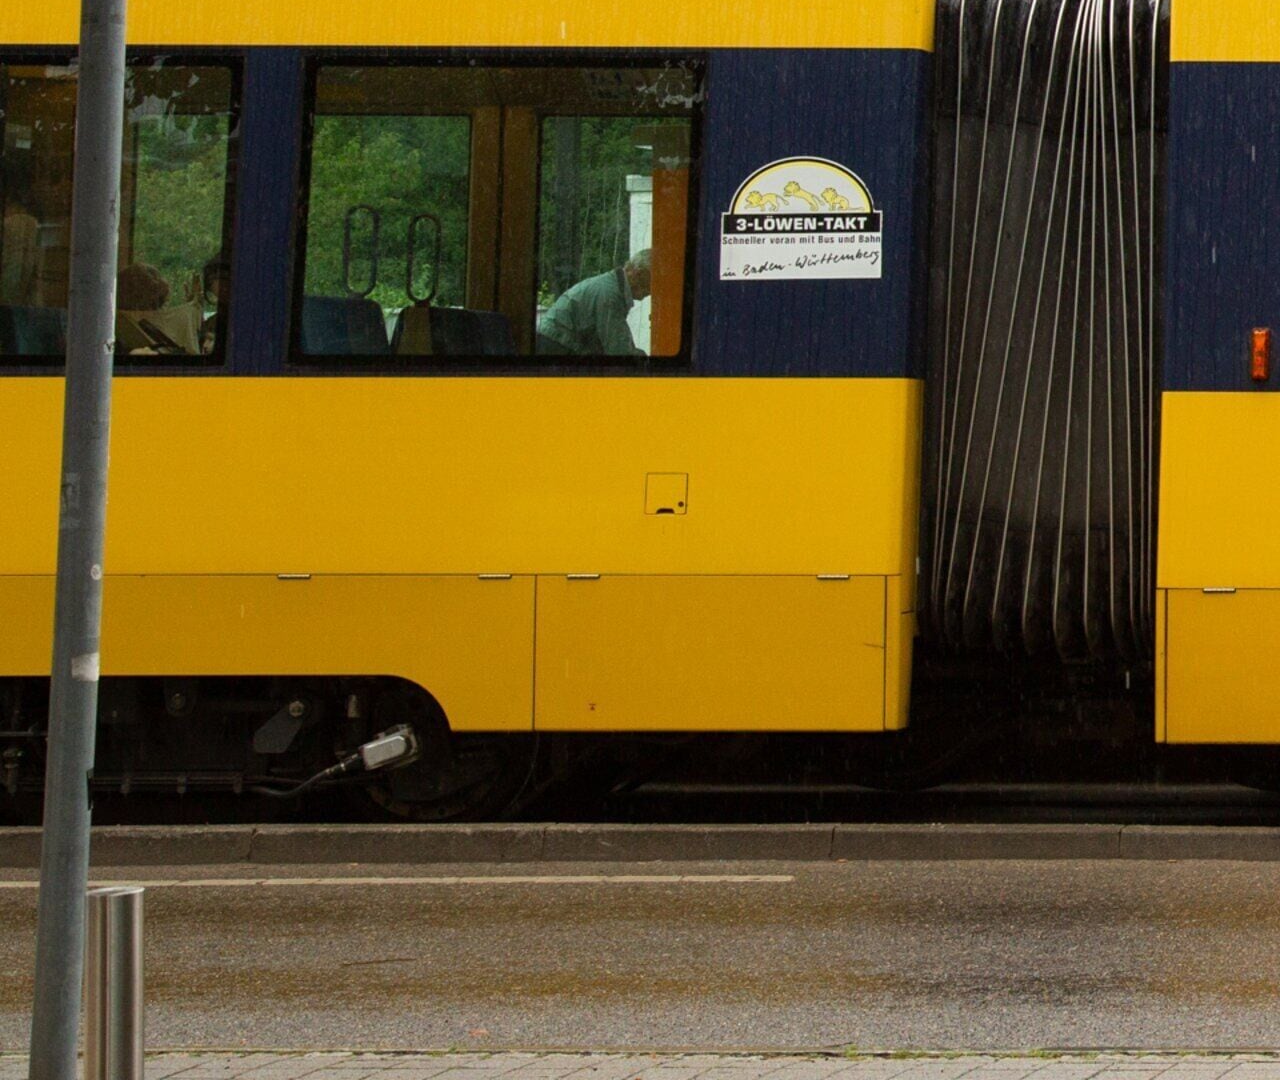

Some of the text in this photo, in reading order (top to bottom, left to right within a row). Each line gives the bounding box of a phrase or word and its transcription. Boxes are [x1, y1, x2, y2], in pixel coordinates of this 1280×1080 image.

[736, 216, 867, 231] 3-LÖWEN-TAKT
[722, 235, 765, 244] Schneller
[799, 235, 815, 244] mit
[818, 236, 834, 244] Bus
[859, 235, 881, 243] Bahn
[722, 268, 736, 277] in
